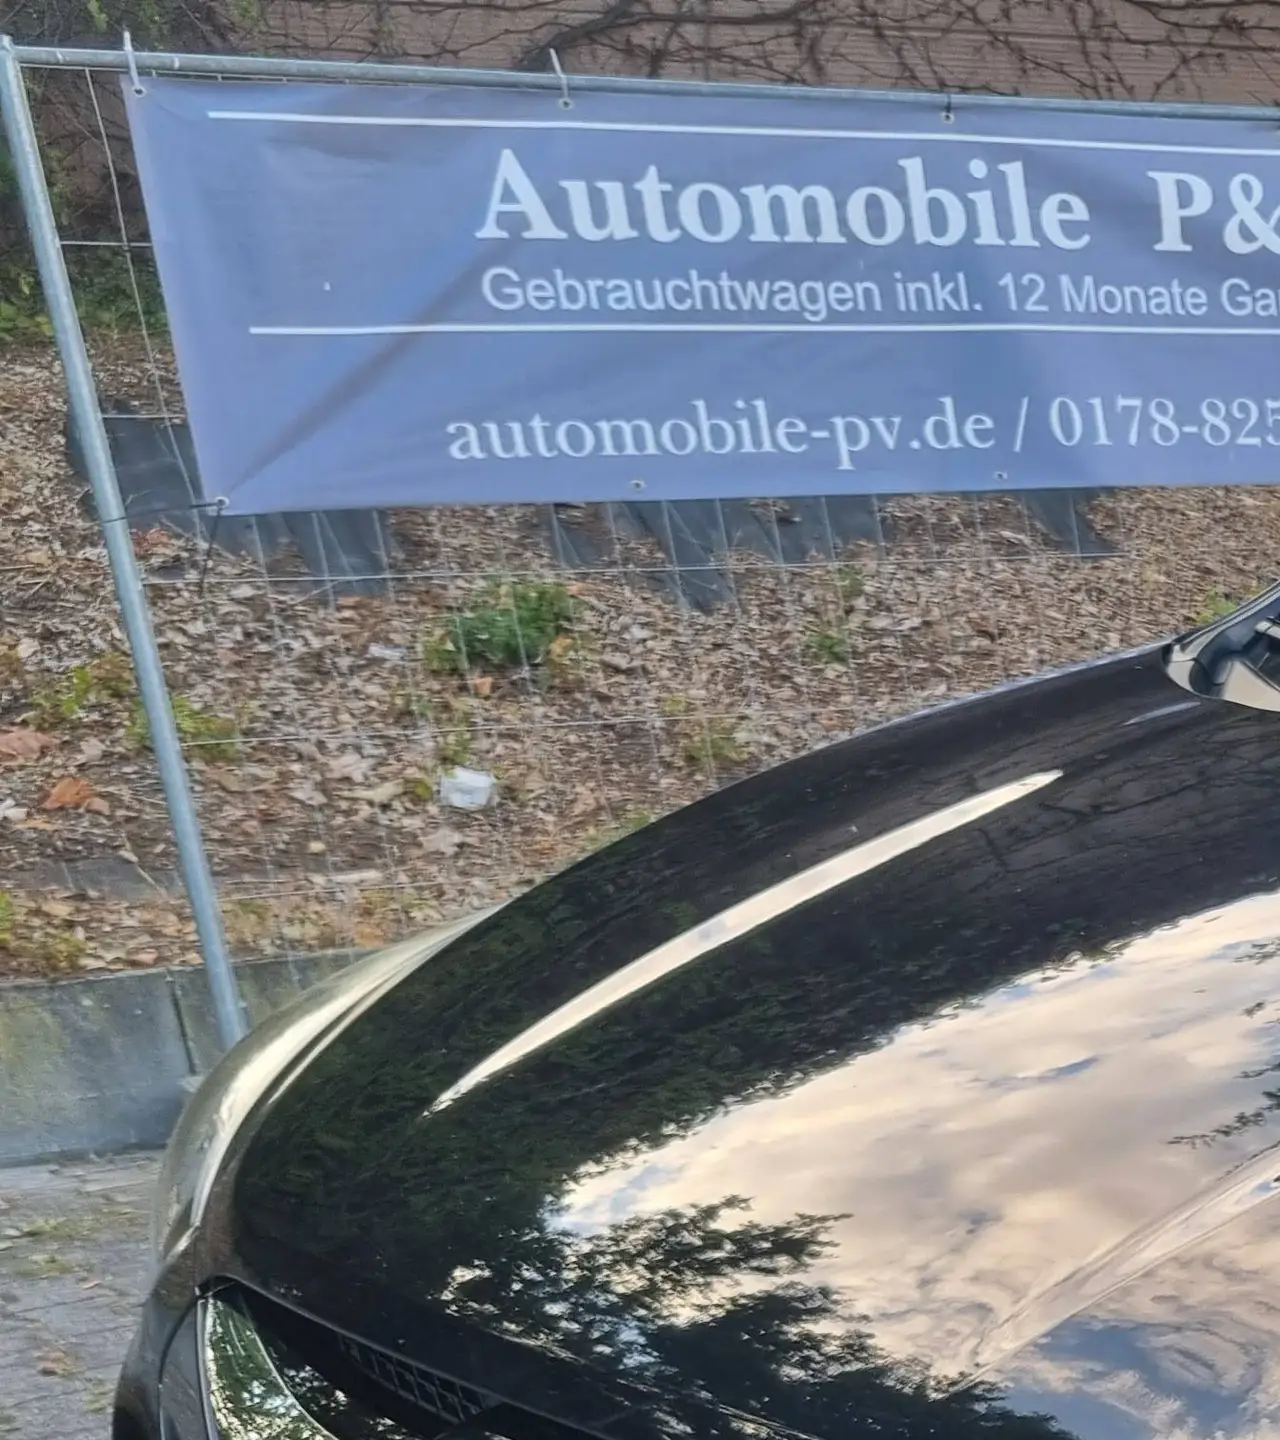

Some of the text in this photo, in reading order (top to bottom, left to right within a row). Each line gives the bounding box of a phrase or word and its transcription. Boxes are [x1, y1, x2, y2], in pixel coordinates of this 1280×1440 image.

[474, 148, 1091, 250] Automobile
[482, 266, 882, 322] Gebrauchtwagen
[895, 271, 982, 312] inkl.
[998, 272, 1049, 312] 12
[1059, 274, 1208, 316] Monate
[446, 395, 995, 470] automobile-pv.de
